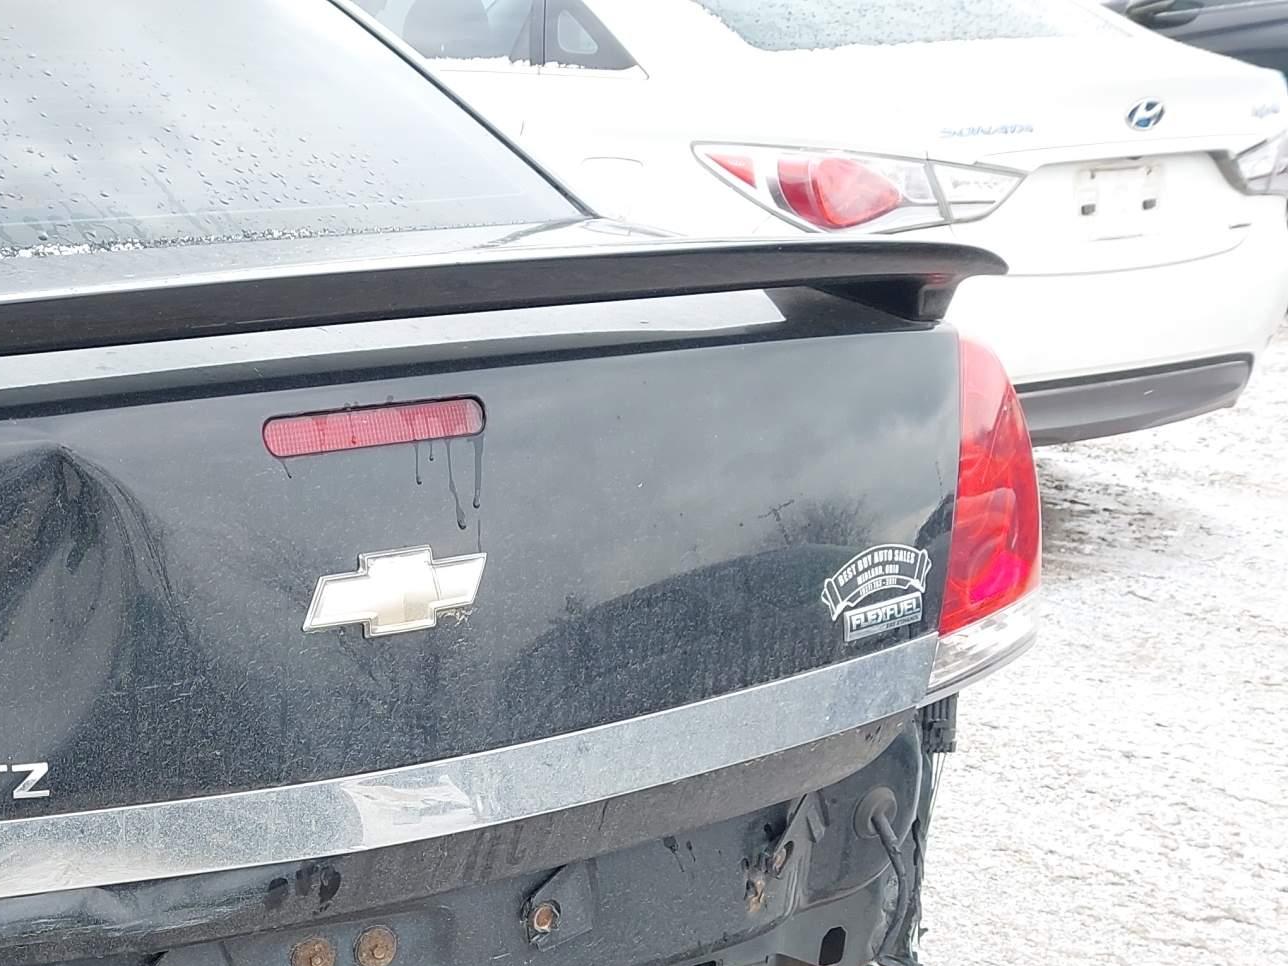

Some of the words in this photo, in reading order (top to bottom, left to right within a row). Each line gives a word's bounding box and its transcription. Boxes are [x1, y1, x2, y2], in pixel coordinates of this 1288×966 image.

[837, 564, 857, 587] BEST
[857, 554, 872, 572] BUY
[873, 549, 893, 564] AUTO
[894, 549, 916, 564] SALES
[852, 599, 920, 630] FLEXFUEL
